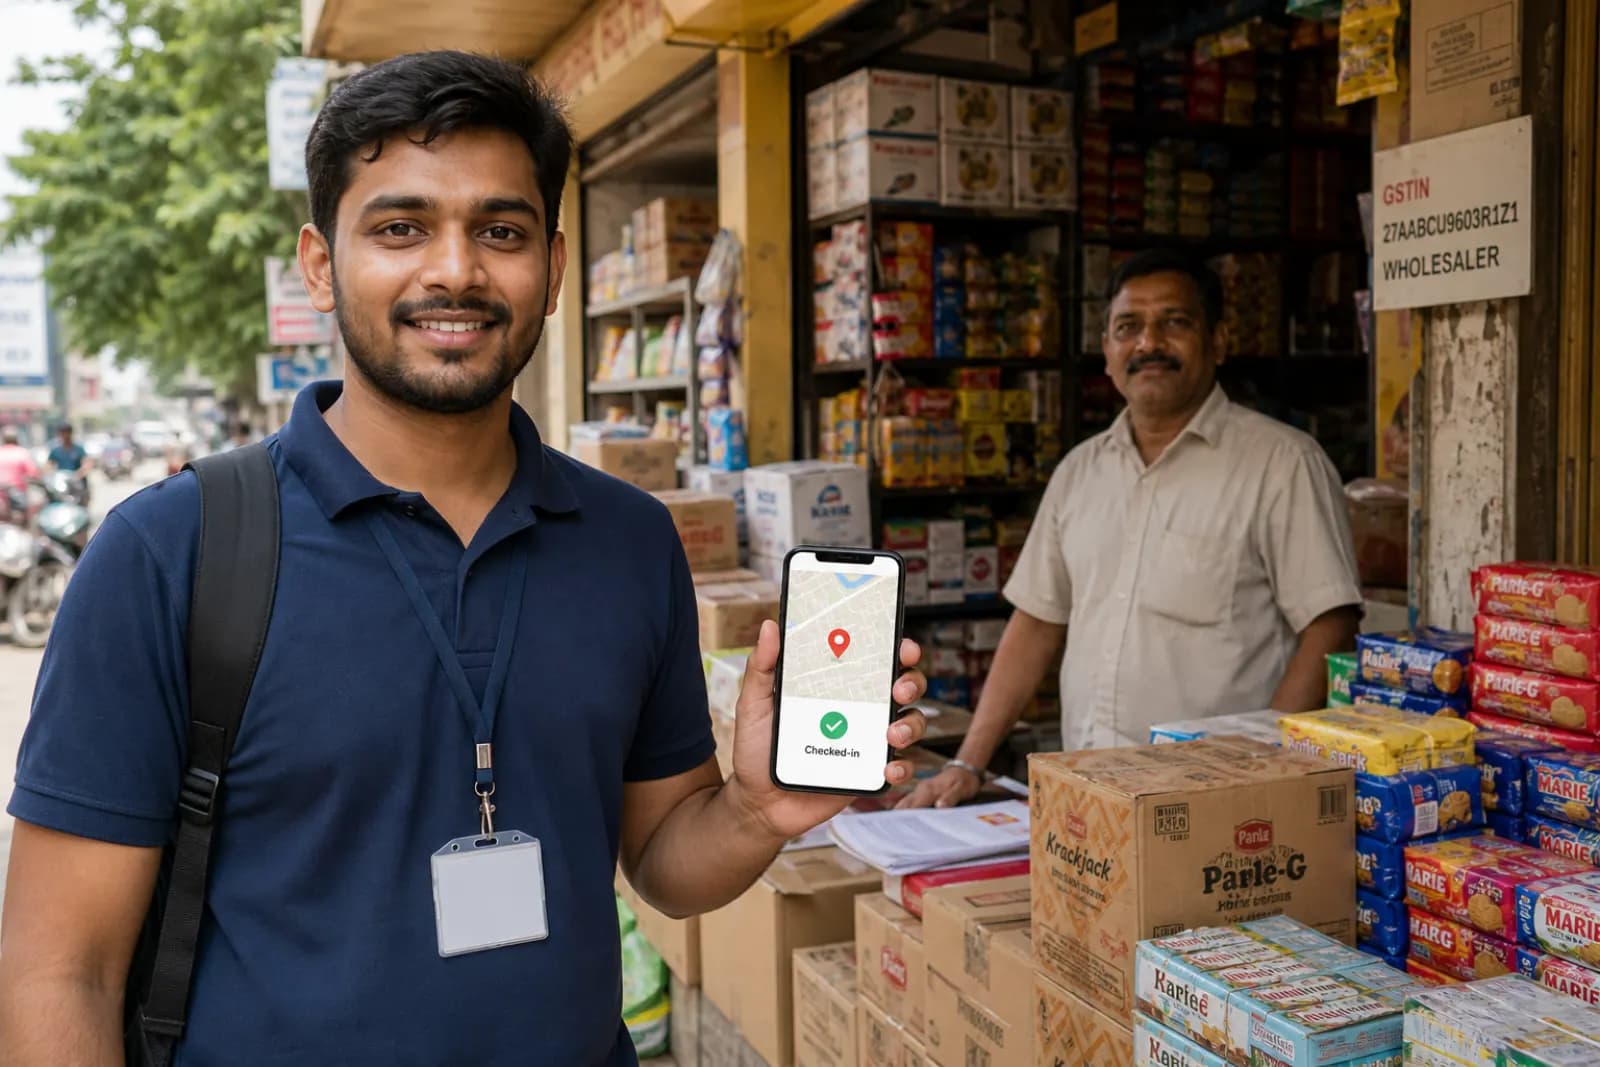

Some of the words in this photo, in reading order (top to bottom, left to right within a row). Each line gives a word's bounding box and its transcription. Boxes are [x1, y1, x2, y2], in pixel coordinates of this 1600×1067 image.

[1383, 176, 1430, 206] GSTIN
[1383, 201, 1519, 243] 27AABCU9603R1Z1
[1383, 245, 1500, 281] WHOLESALER
[804, 745, 860, 758] Checked-in
[1537, 772, 1590, 802] MARIE
[1045, 831, 1112, 882] Krackjack
[1539, 834, 1590, 862] MARIE
[1545, 905, 1600, 943] MARIE
